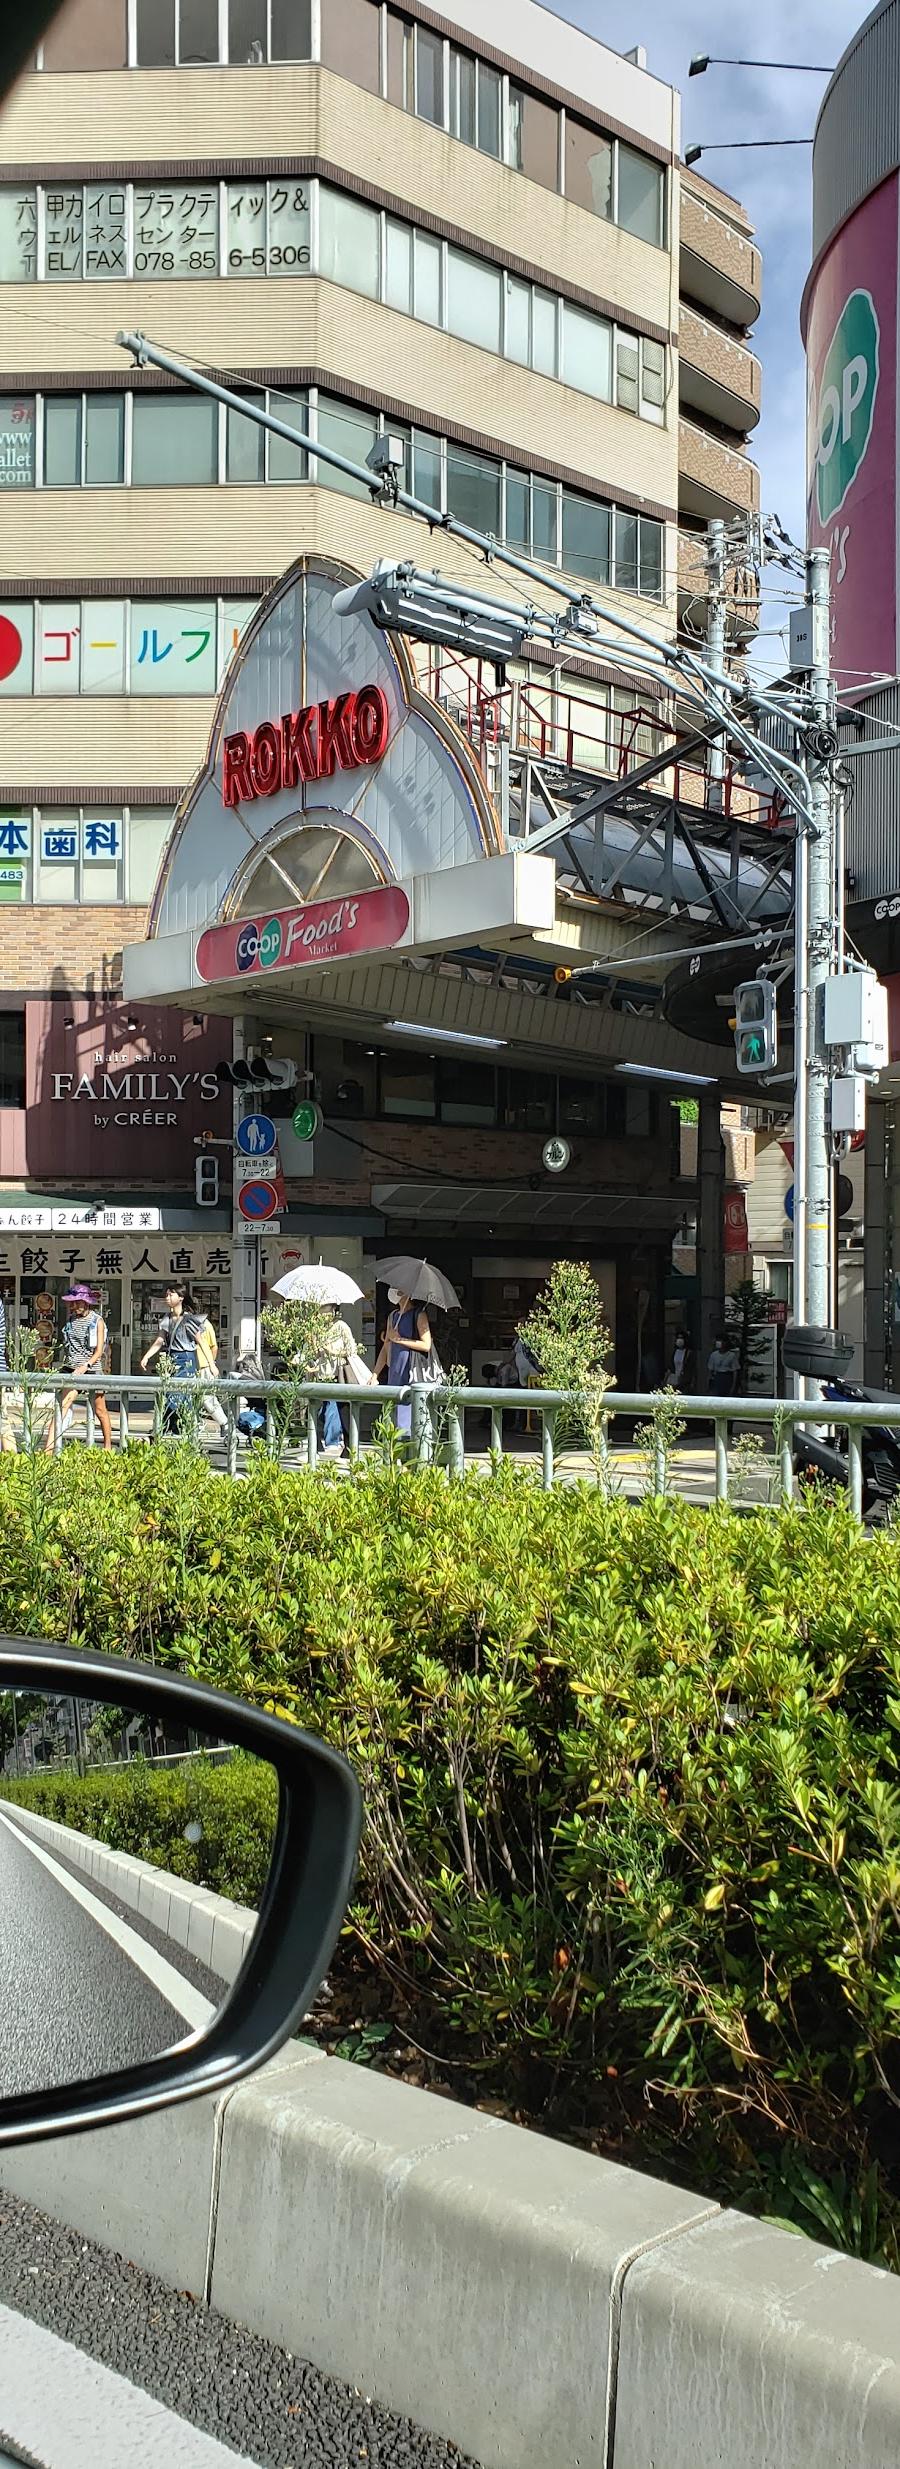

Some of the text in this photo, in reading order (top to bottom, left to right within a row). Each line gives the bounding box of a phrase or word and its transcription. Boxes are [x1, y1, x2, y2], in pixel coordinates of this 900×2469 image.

[223, 684, 389, 807] ROKKO
[284, 900, 360, 957] Food's
[94, 1051, 177, 1064] hair salon
[51, 1072, 219, 1101] FAMILY'S
[94, 1109, 178, 1128] by CRÉER
[58, 1212, 153, 1226] 24時間営業
